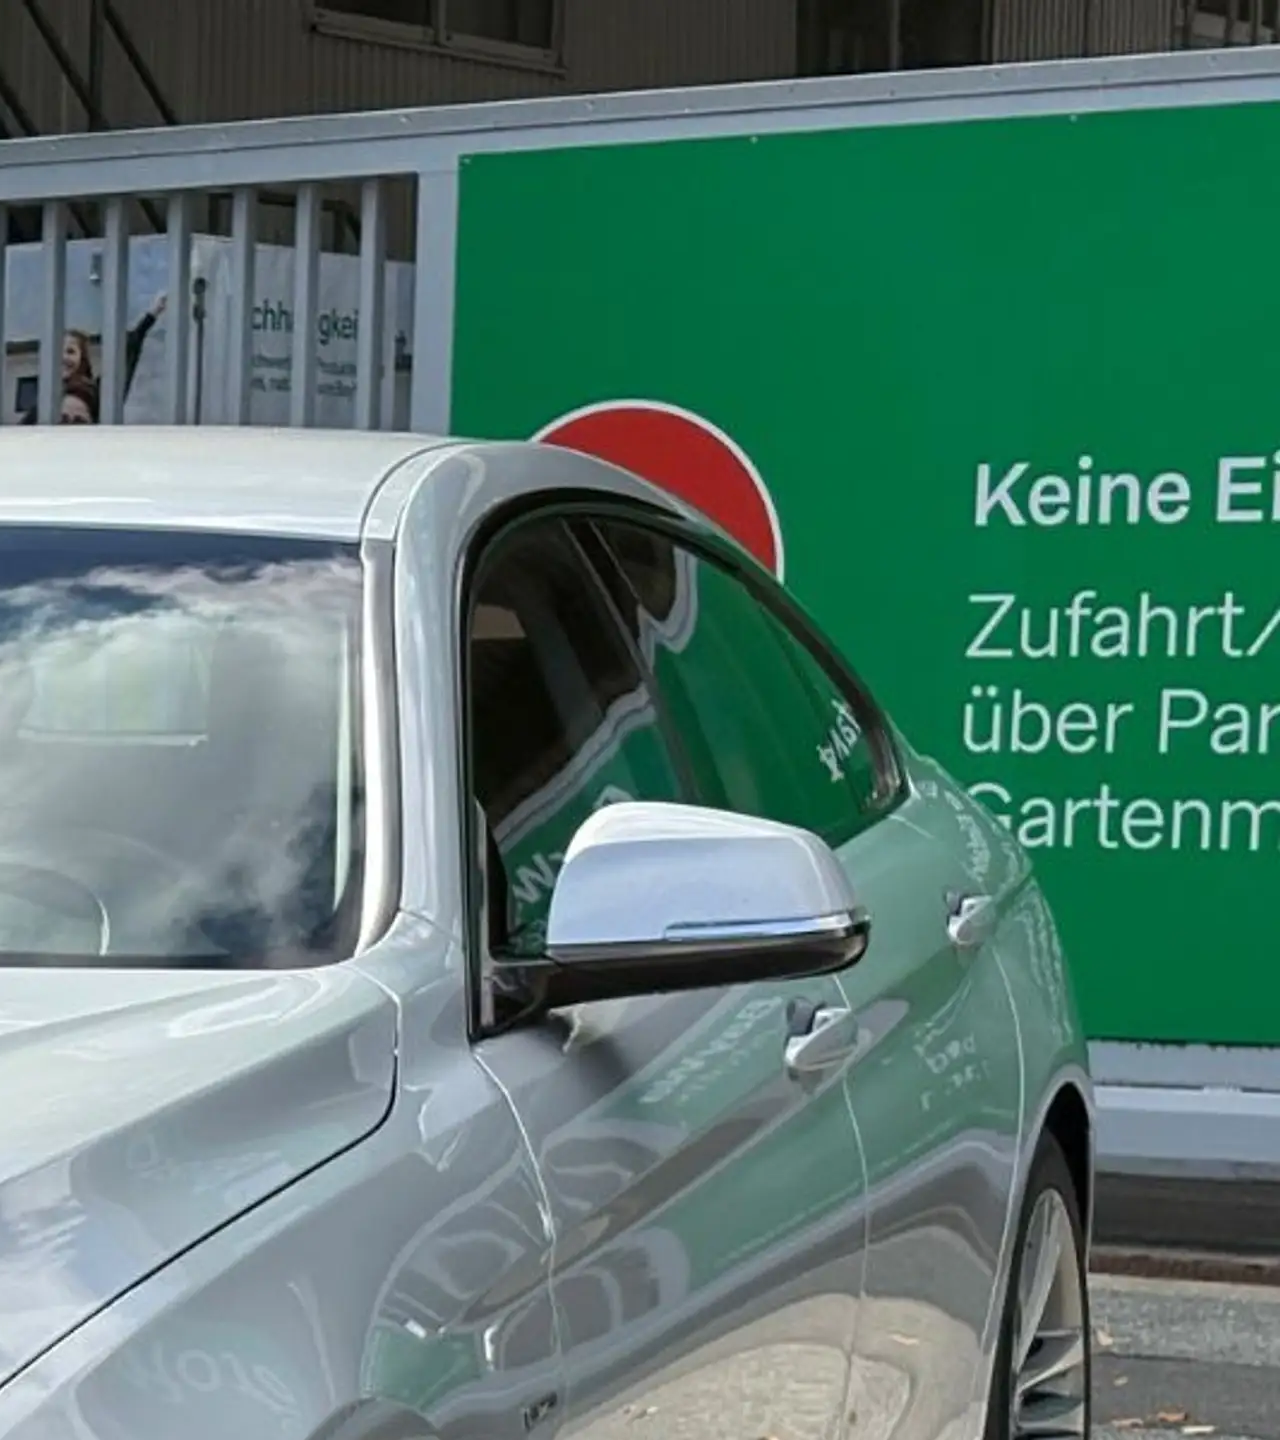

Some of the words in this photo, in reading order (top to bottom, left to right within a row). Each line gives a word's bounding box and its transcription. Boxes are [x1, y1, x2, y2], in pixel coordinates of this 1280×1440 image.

[975, 455, 1191, 526] Keine
[965, 590, 1280, 658] Zufahrt/
[963, 685, 1133, 753] über
[1158, 687, 1280, 754] Par
